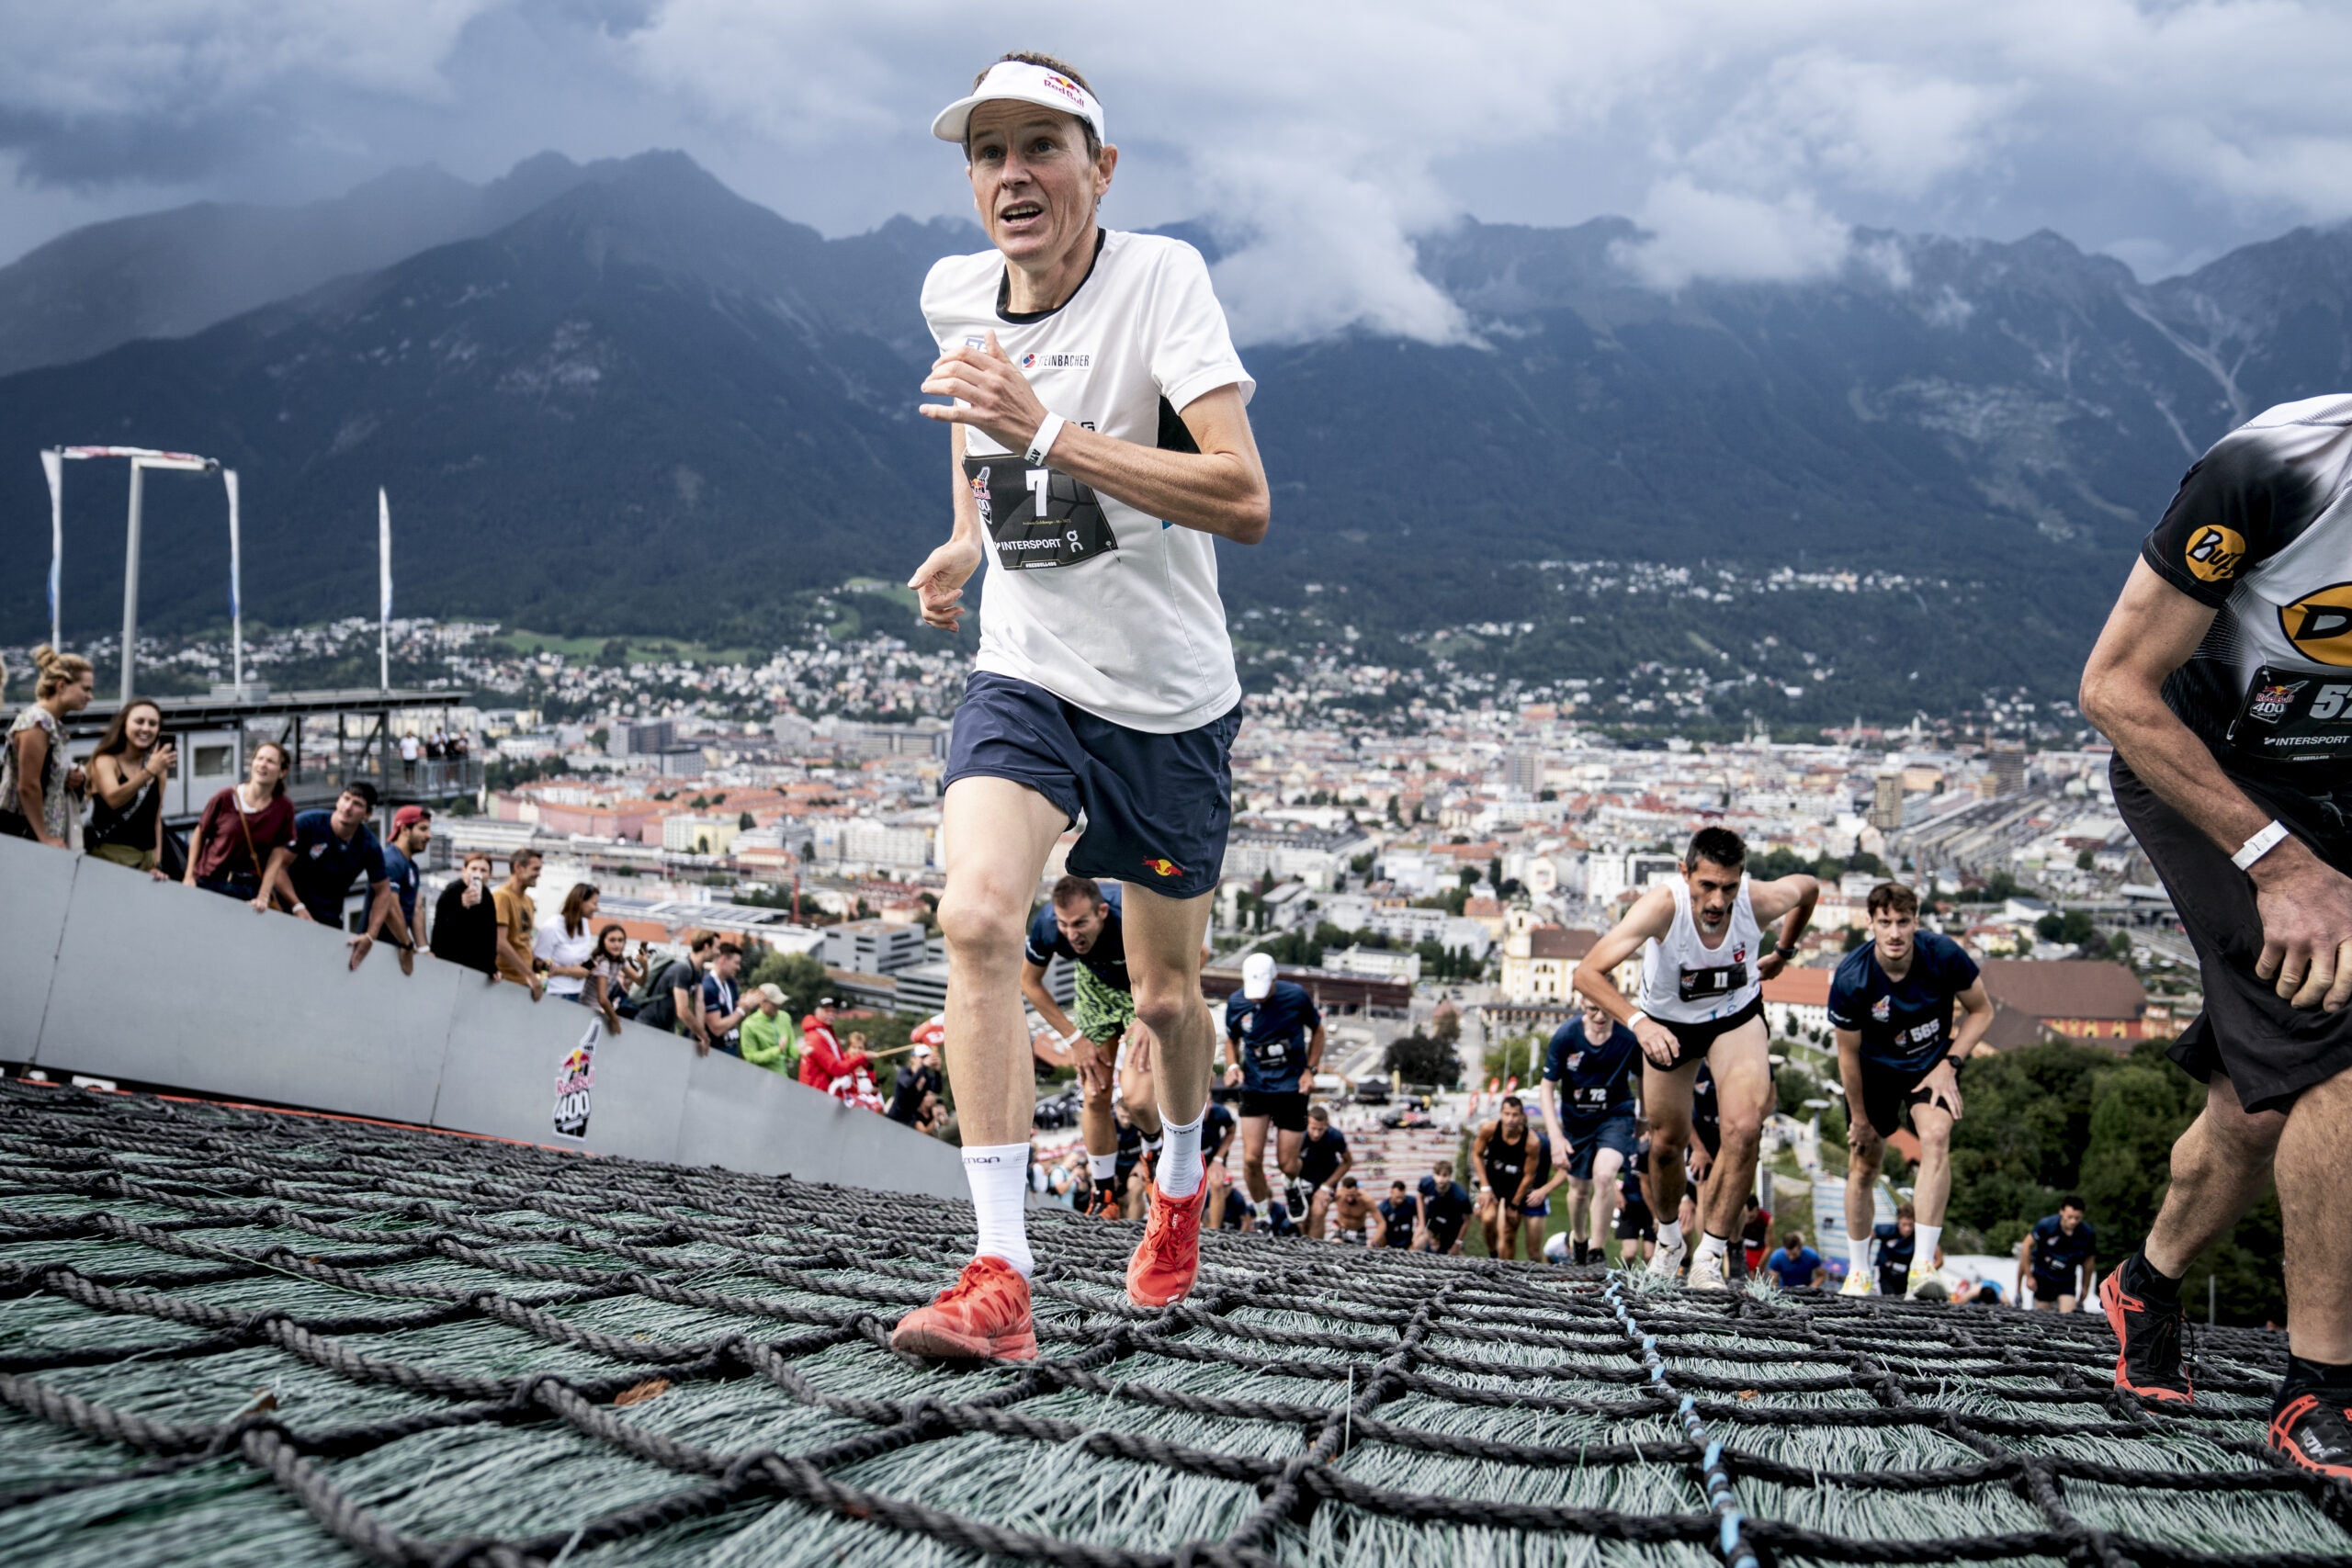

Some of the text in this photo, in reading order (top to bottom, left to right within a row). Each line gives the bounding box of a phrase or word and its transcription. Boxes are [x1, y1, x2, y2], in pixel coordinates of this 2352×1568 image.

[1044, 79, 1085, 107] Red Bull
[1025, 468, 1049, 516] 7
[1001, 538, 1061, 551] INTERSPORT
[2252, 702, 2285, 713] 400
[2256, 693, 2295, 704] Red Bull
[2275, 735, 2350, 746] INTERSPORT
[1910, 1018, 1940, 1043] 565
[557, 1069, 595, 1095] Red Bull
[1589, 1089, 1607, 1101] 72
[555, 1089, 590, 1122] 400
